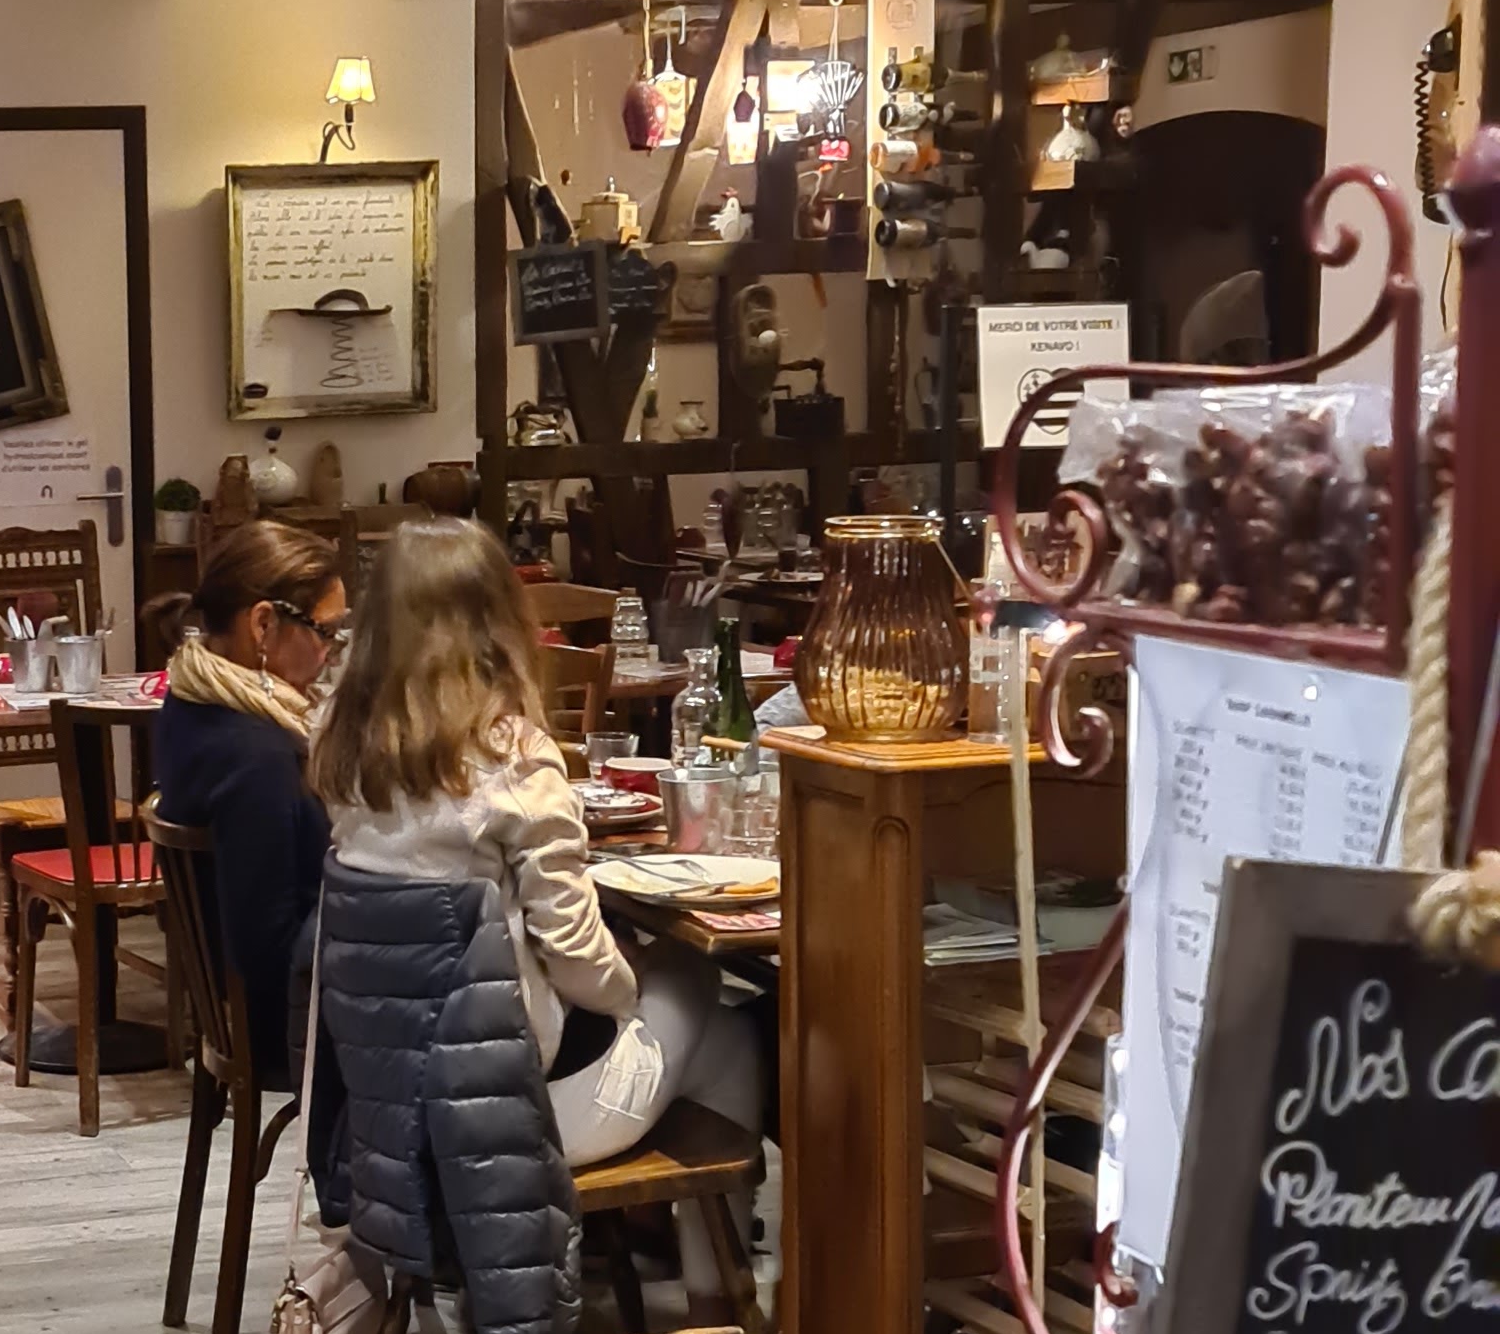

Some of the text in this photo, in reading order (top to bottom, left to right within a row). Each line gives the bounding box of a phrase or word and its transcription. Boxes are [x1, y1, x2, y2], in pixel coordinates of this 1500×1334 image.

[988, 321, 1023, 333] MERCI
[1025, 320, 1040, 332] DE
[1043, 319, 1079, 332] VOTRE
[1275, 979, 1409, 1133] Nos
